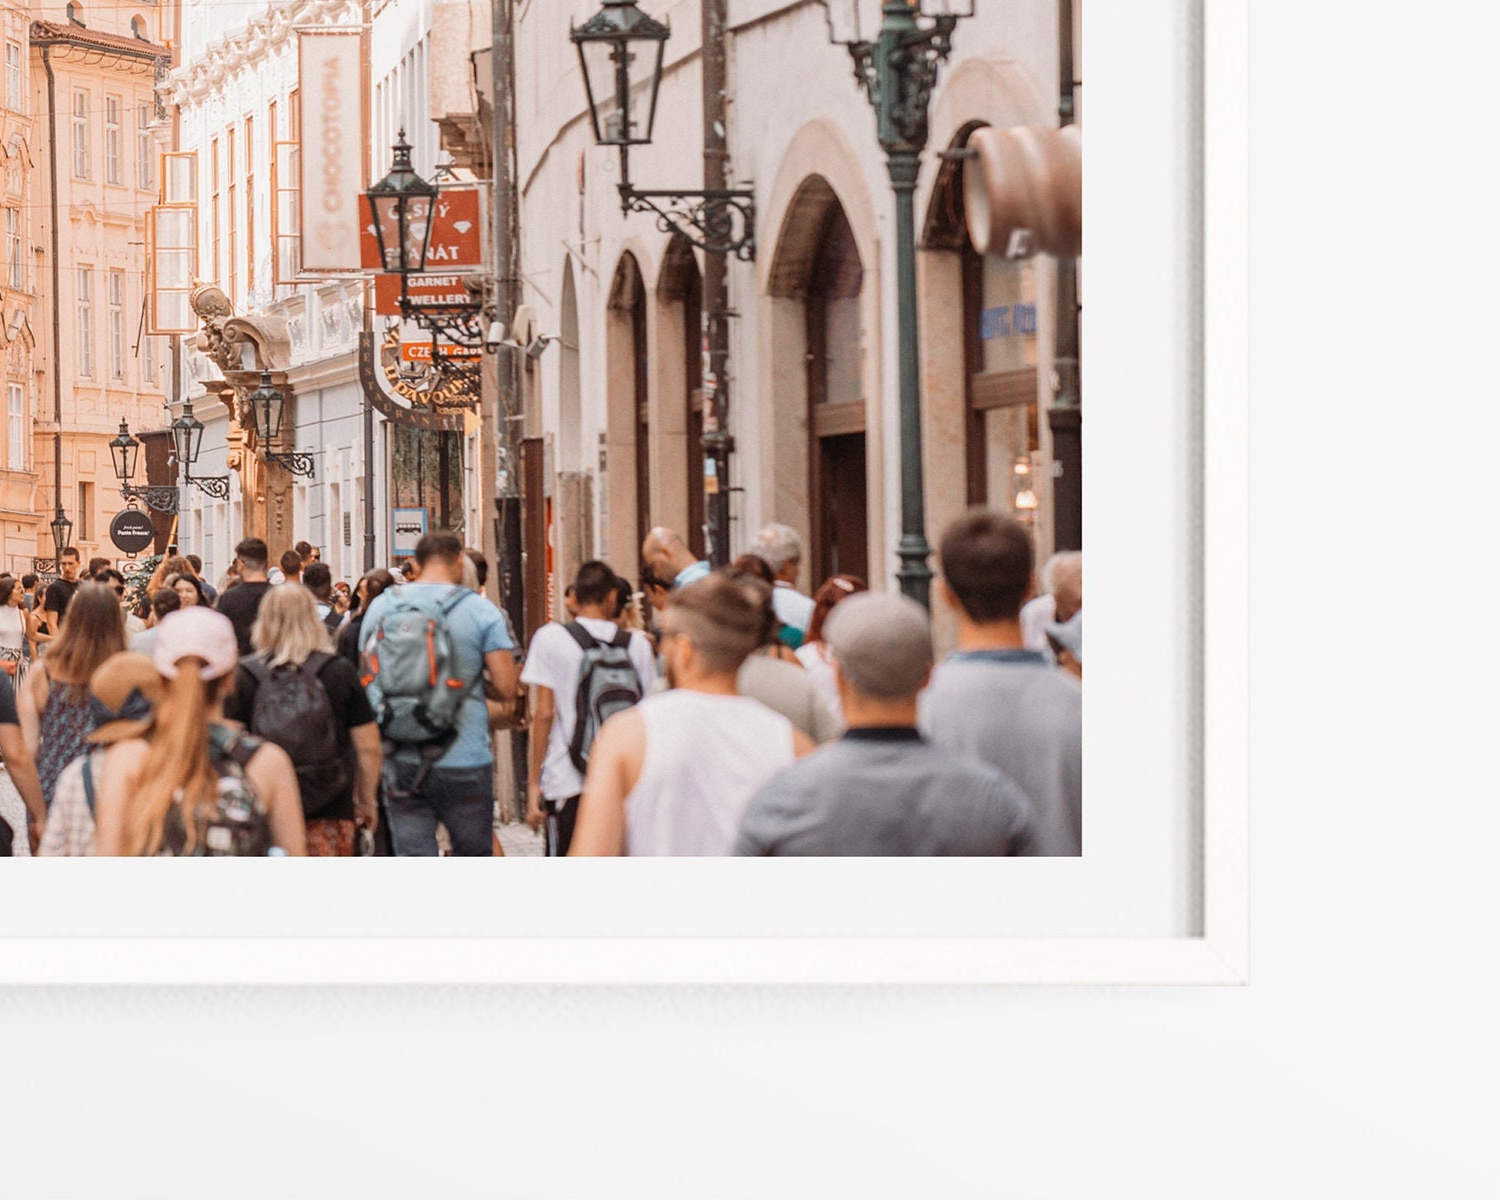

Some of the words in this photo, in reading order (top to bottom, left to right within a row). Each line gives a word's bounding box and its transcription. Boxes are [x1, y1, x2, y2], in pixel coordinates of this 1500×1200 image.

[384, 243, 460, 262] ANÁT
[406, 276, 459, 288] GARNET
[393, 294, 472, 306] JWELLERY
[407, 346, 449, 358] CZEH
